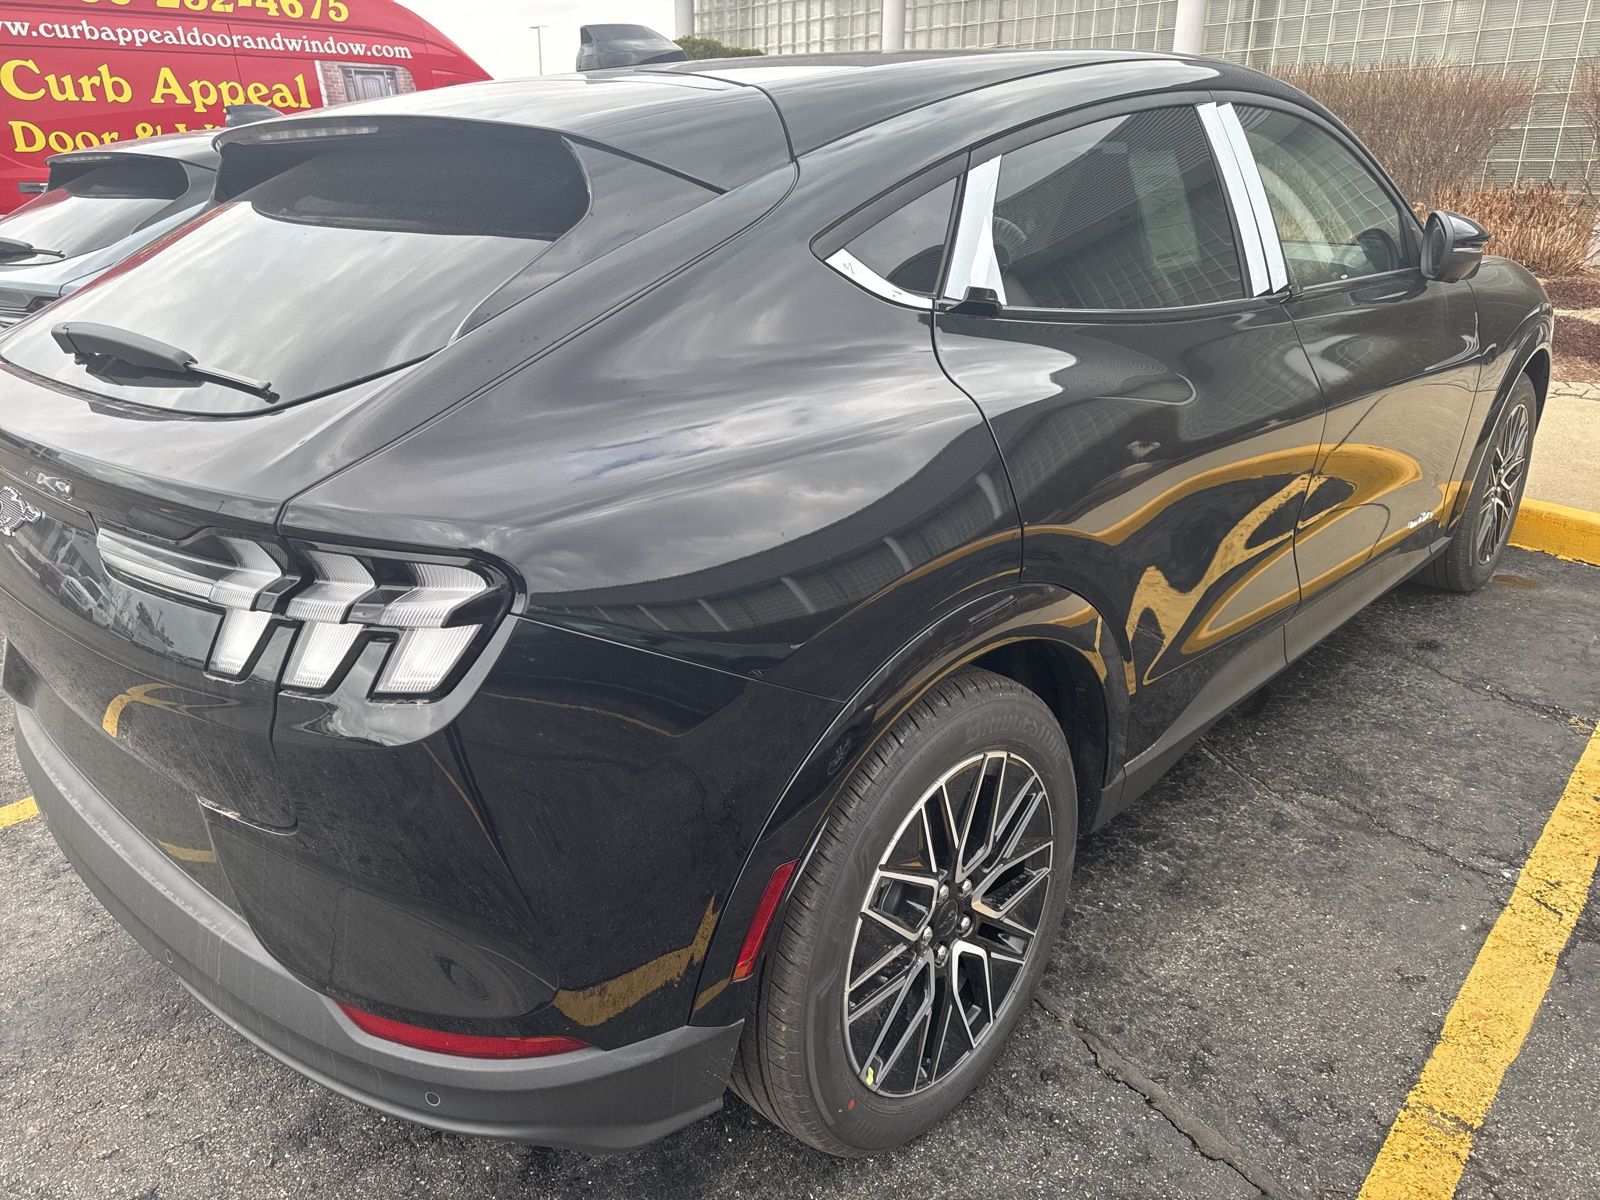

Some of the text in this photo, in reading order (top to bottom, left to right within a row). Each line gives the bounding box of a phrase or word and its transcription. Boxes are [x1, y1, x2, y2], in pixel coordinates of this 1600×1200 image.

[0, 21, 412, 59] w.curbappealdoorandwindow.com
[0, 59, 312, 113] Curb Appeal
[8, 120, 119, 153] Door
